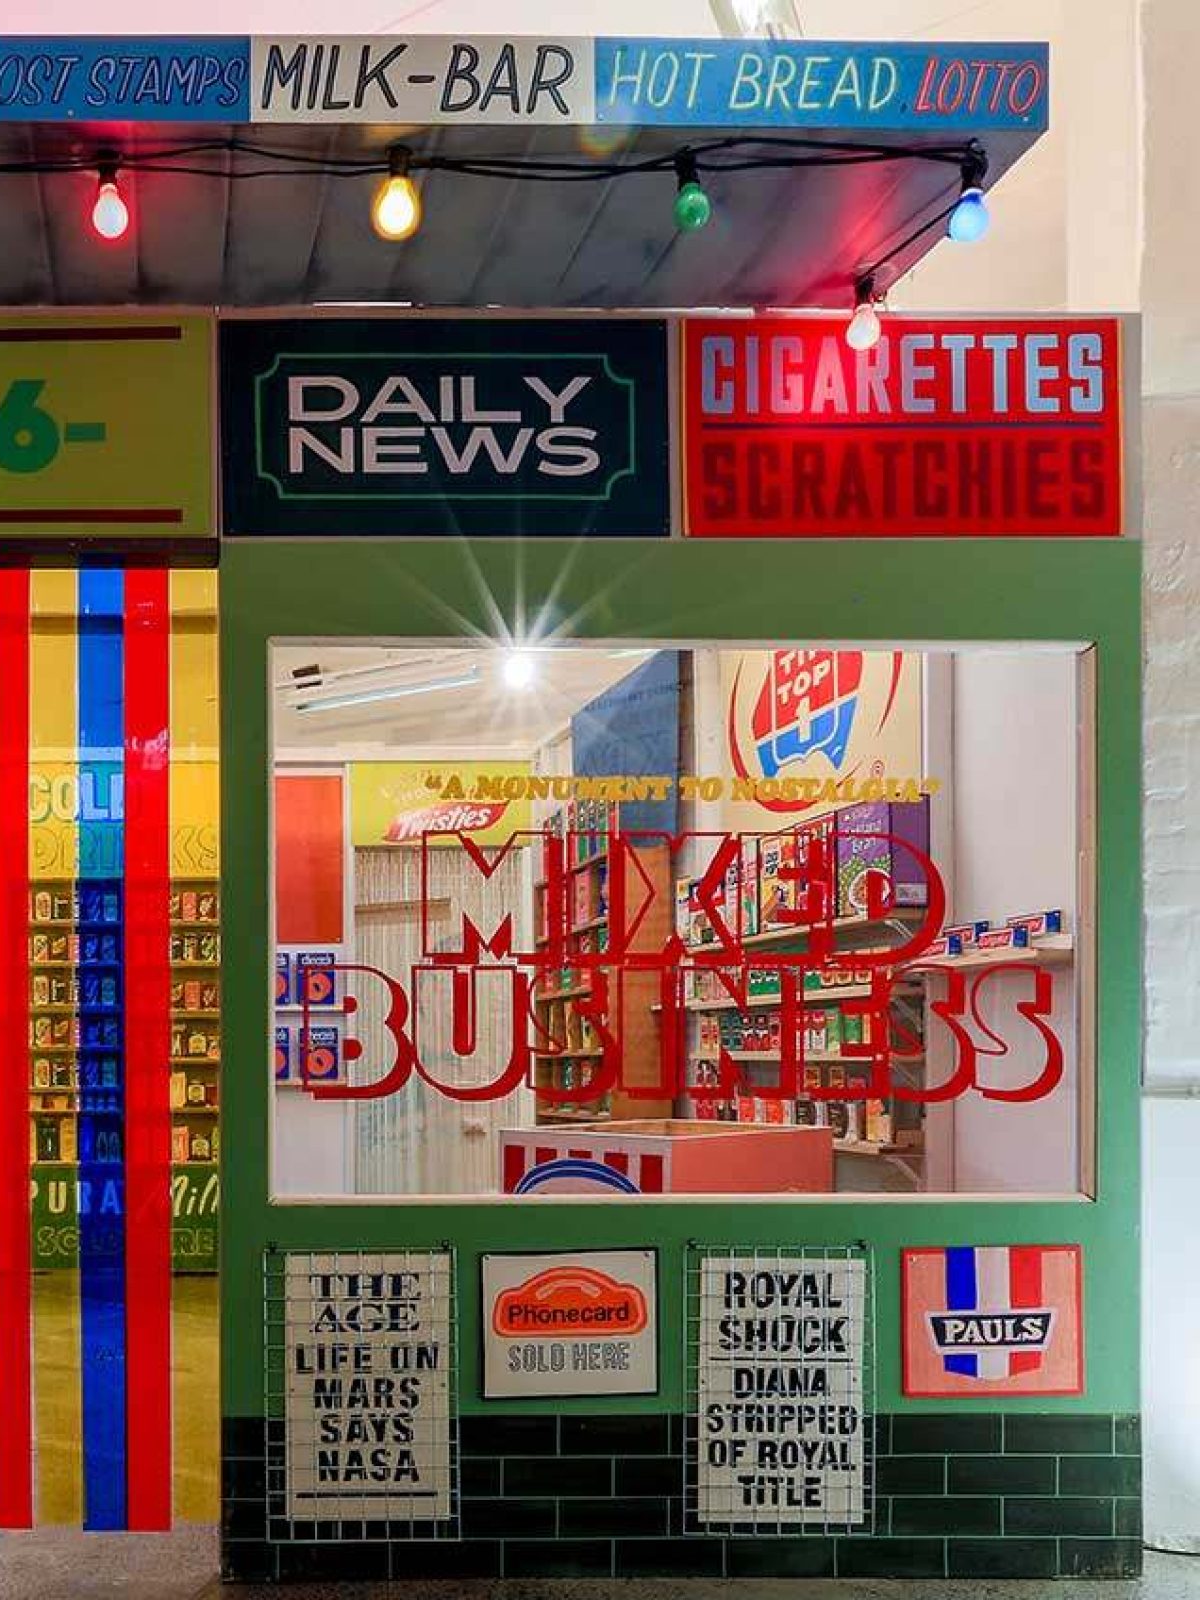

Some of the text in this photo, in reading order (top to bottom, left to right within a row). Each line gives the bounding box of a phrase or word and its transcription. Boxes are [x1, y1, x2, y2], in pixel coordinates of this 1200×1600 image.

[84, 56, 249, 108] STAMPS
[261, 43, 574, 114] MILK-BAR
[609, 51, 703, 112] HOT
[914, 56, 1046, 117] LOTTO
[701, 333, 1105, 417] CIGARETTES
[288, 376, 593, 423] DAILY
[288, 426, 600, 474] NEWS
[703, 439, 1107, 525] SCRATCHIES
[776, 659, 831, 705] TOP
[475, 775, 675, 801] MONUMENT
[679, 776, 725, 801] TO
[422, 831, 946, 964] MIXED
[304, 963, 1064, 1103] BUSINESS
[309, 1272, 422, 1300] THE
[724, 1271, 843, 1309] ROYAL
[309, 1302, 420, 1333] AGE
[507, 1300, 631, 1326] Phonecard
[717, 1315, 850, 1354] SHOCK
[942, 1317, 1048, 1345] PAULS
[296, 1342, 440, 1375] LIFE ON
[506, 1342, 632, 1374] SOLD HERE
[313, 1377, 422, 1410] MARS
[734, 1367, 832, 1399] DIANA
[320, 1413, 415, 1444] SAYS
[705, 1404, 858, 1436] STRIPPED
[317, 1449, 420, 1483] NASA
[708, 1439, 856, 1471] OF ROYAL
[737, 1475, 823, 1508] TITLE
